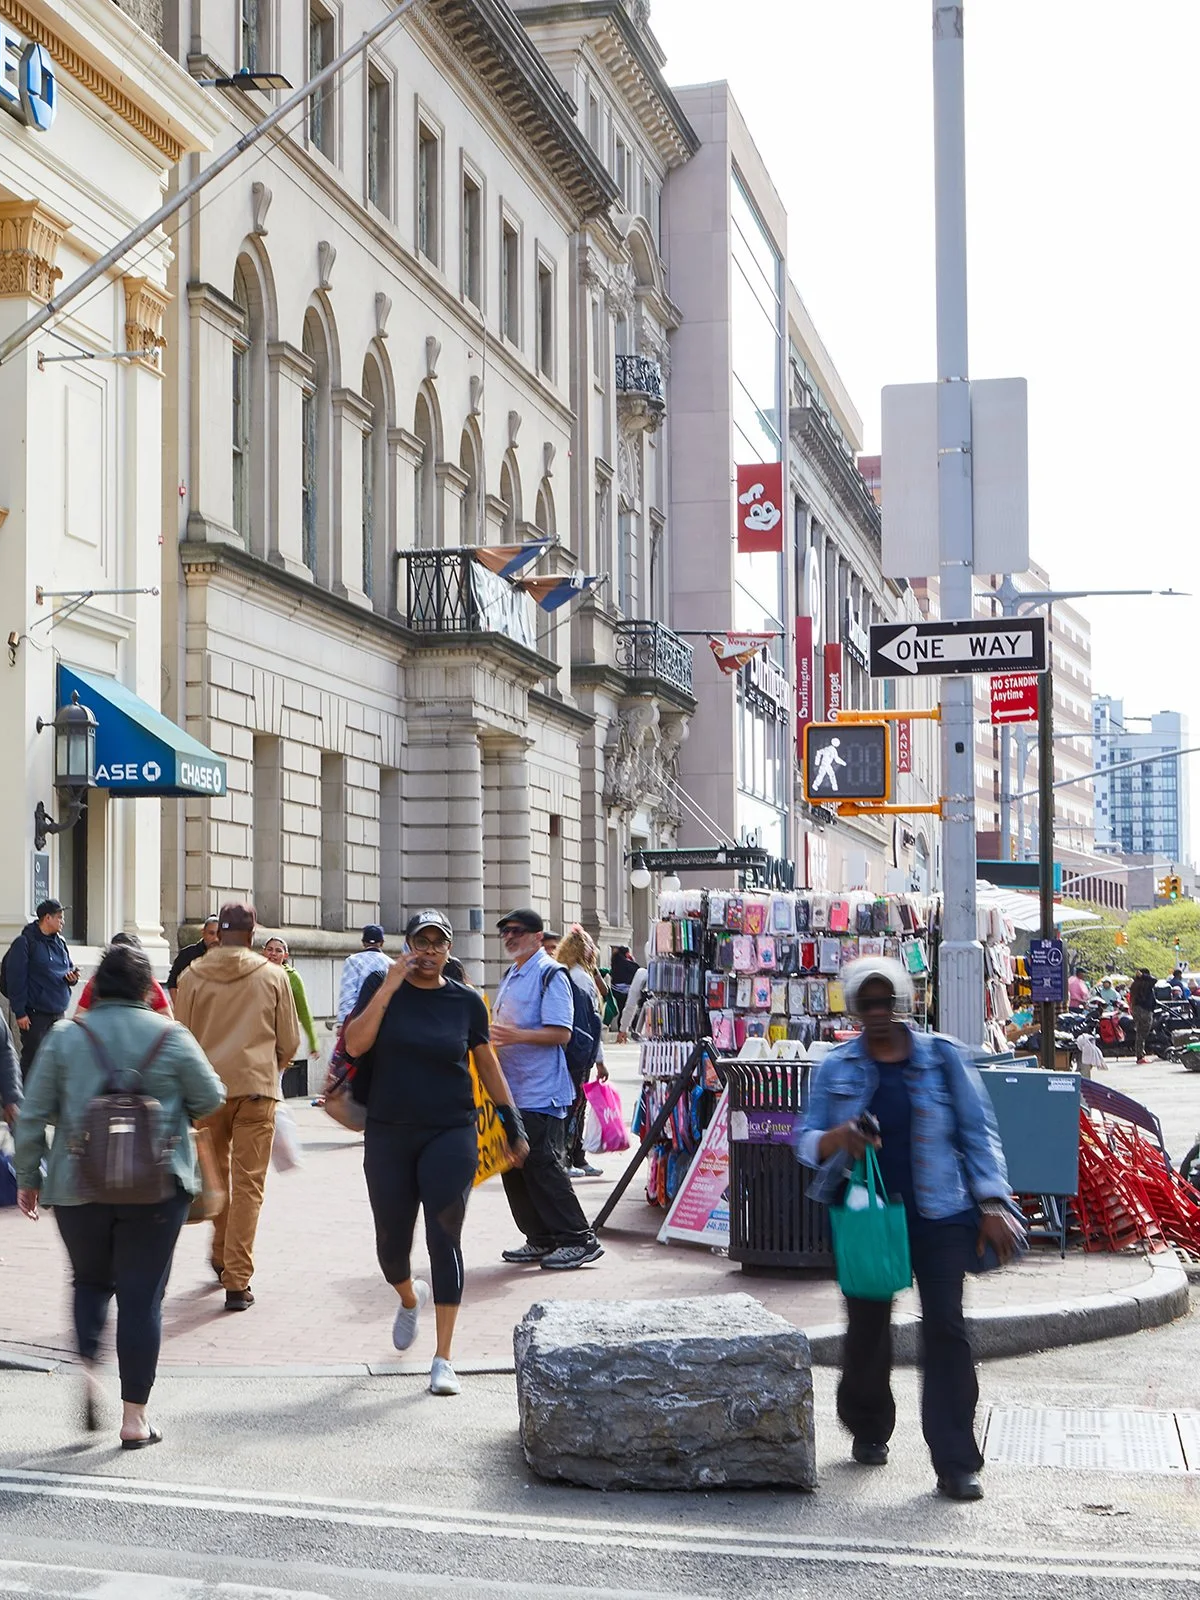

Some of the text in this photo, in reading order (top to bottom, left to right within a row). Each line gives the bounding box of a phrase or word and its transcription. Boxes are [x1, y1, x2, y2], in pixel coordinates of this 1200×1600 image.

[896, 635, 1021, 660] ONE WAY
[798, 657, 810, 719] Burlington
[829, 672, 841, 709] target
[992, 678, 1003, 690] NO
[992, 690, 1024, 702] Anytime
[900, 723, 908, 768] PANDA
[95, 763, 139, 780] ASE
[181, 762, 213, 789] CHASE
